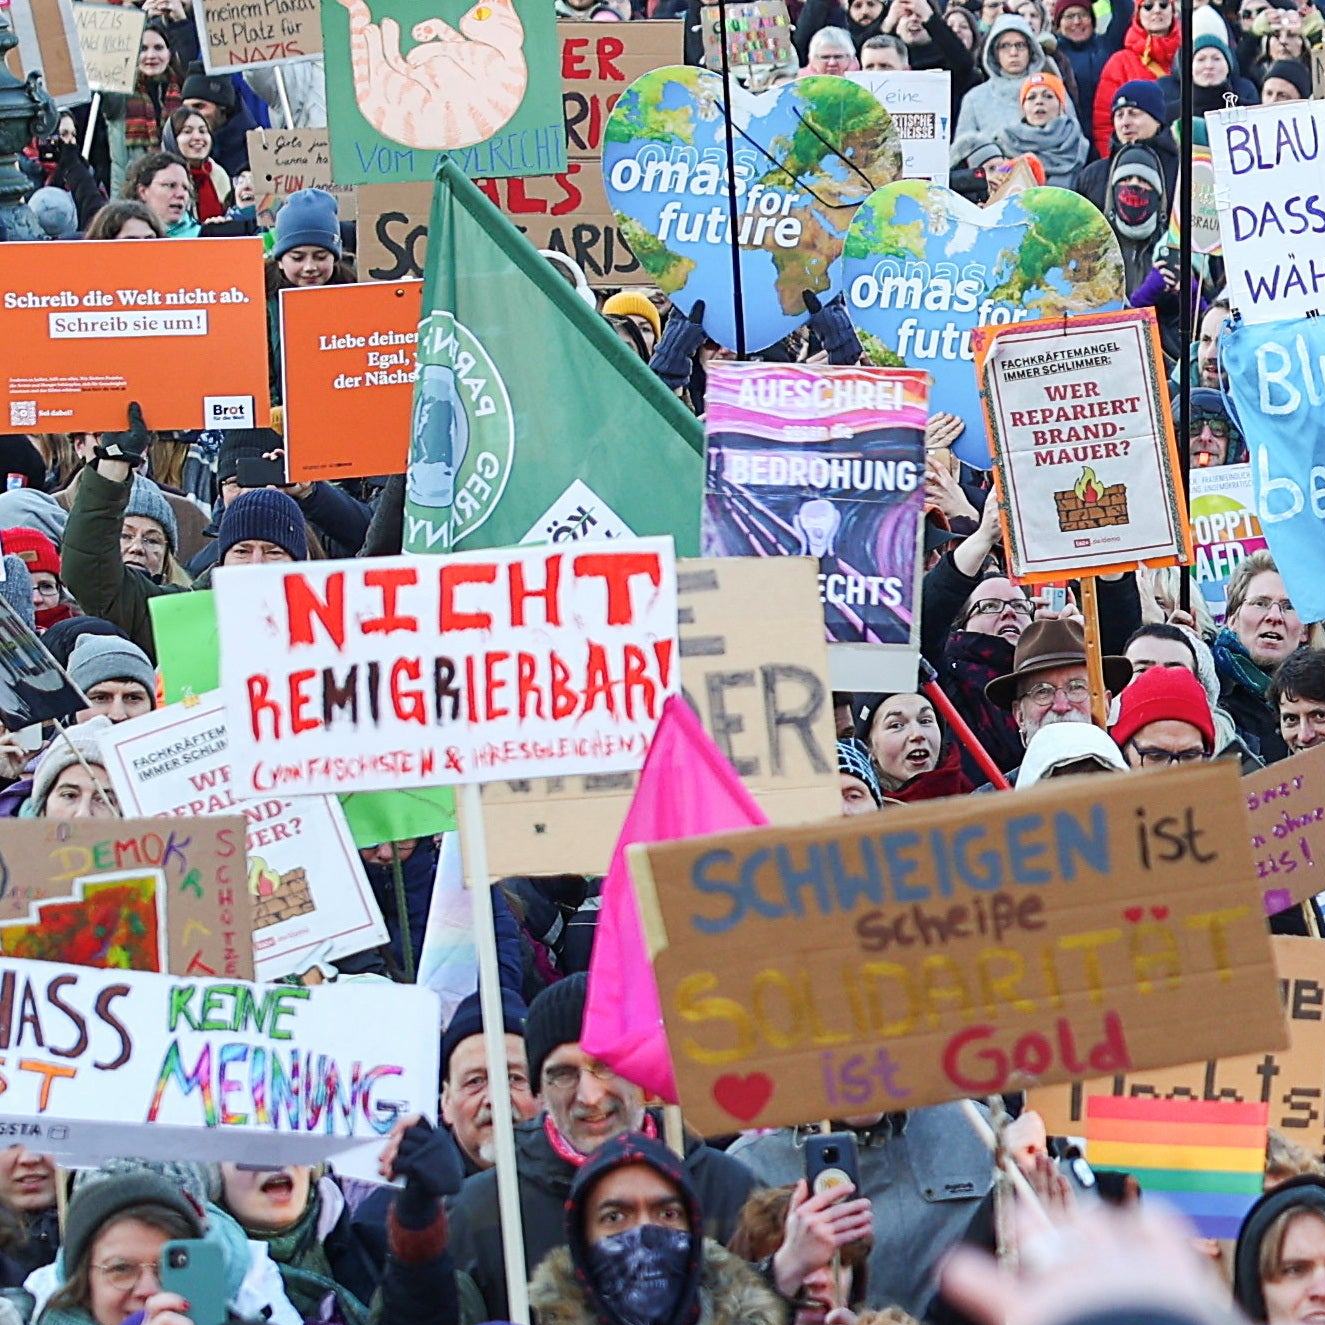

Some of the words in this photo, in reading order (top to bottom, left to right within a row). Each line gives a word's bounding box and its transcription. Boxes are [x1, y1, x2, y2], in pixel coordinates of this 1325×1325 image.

[231, 23, 275, 47] Platz
[280, 18, 304, 35] für
[228, 40, 306, 66] NAZIS
[354, 142, 415, 175] VOM
[1226, 115, 1319, 175] BLAU
[273, 174, 305, 194] FUN
[610, 157, 747, 197] omas
[746, 184, 800, 216] for
[658, 202, 802, 249] future
[4, 290, 80, 309] Schreib
[82, 289, 114, 307] die
[117, 288, 163, 306] Welt
[165, 287, 217, 305] nicht
[219, 286, 250, 304] ab.
[850, 272, 978, 311] omas
[54, 315, 128, 333] Schreib
[133, 315, 159, 332] sie
[978, 299, 1028, 327] for
[319, 333, 366, 351] Liebe
[1000, 342, 1121, 370] FACHKRÄFTEMANGEL
[367, 351, 411, 369] Egal,
[1003, 366, 1041, 382] IMMER
[333, 373, 362, 389] der
[736, 377, 906, 412] AUFSCHREI
[1044, 380, 1101, 402] WER
[212, 403, 245, 416] Brot
[1010, 396, 1141, 428] REPARIERT
[1032, 422, 1126, 447] BRAND-
[1034, 439, 1131, 467] MAUER?
[731, 454, 919, 492] BEDROHUNG
[283, 552, 662, 652] NICHT
[246, 638, 674, 744] REMIGRIERBAR!
[690, 803, 1111, 936] SCHWEIGEN
[1135, 806, 1218, 871] ist
[673, 905, 1252, 1065] SOLIDARITÄT
[168, 984, 311, 1041] KEINE
[822, 1047, 911, 1106] ist
[942, 1009, 1134, 1093] Gold
[146, 1038, 405, 1137] MEINUNG
